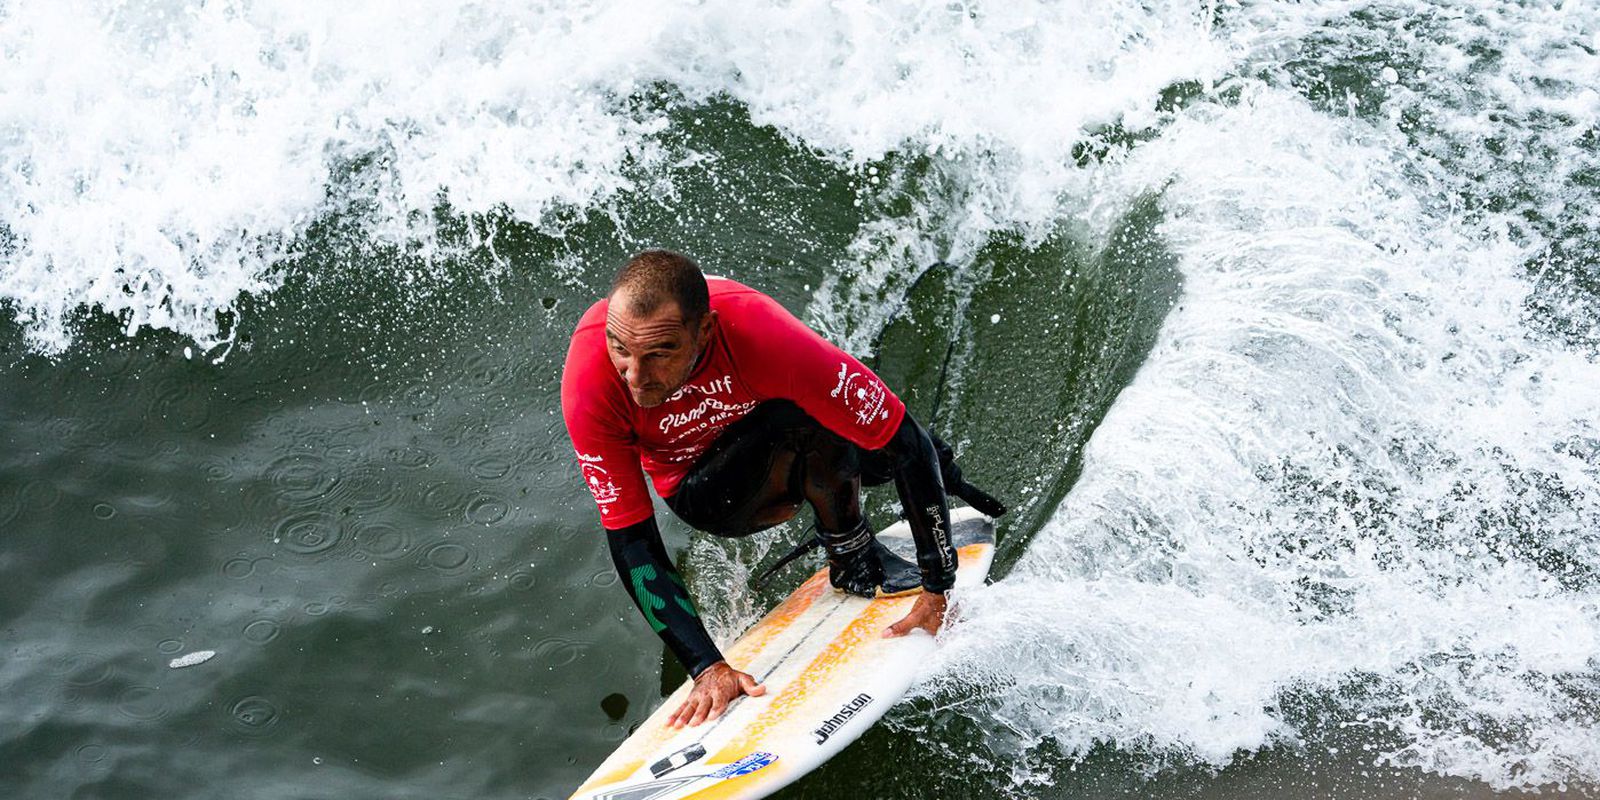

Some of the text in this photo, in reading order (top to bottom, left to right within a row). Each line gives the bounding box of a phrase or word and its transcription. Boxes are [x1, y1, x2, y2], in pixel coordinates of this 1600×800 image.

[659, 401, 707, 434] Pismo
[709, 411, 734, 424] PARA
[815, 692, 872, 746] Johnston
